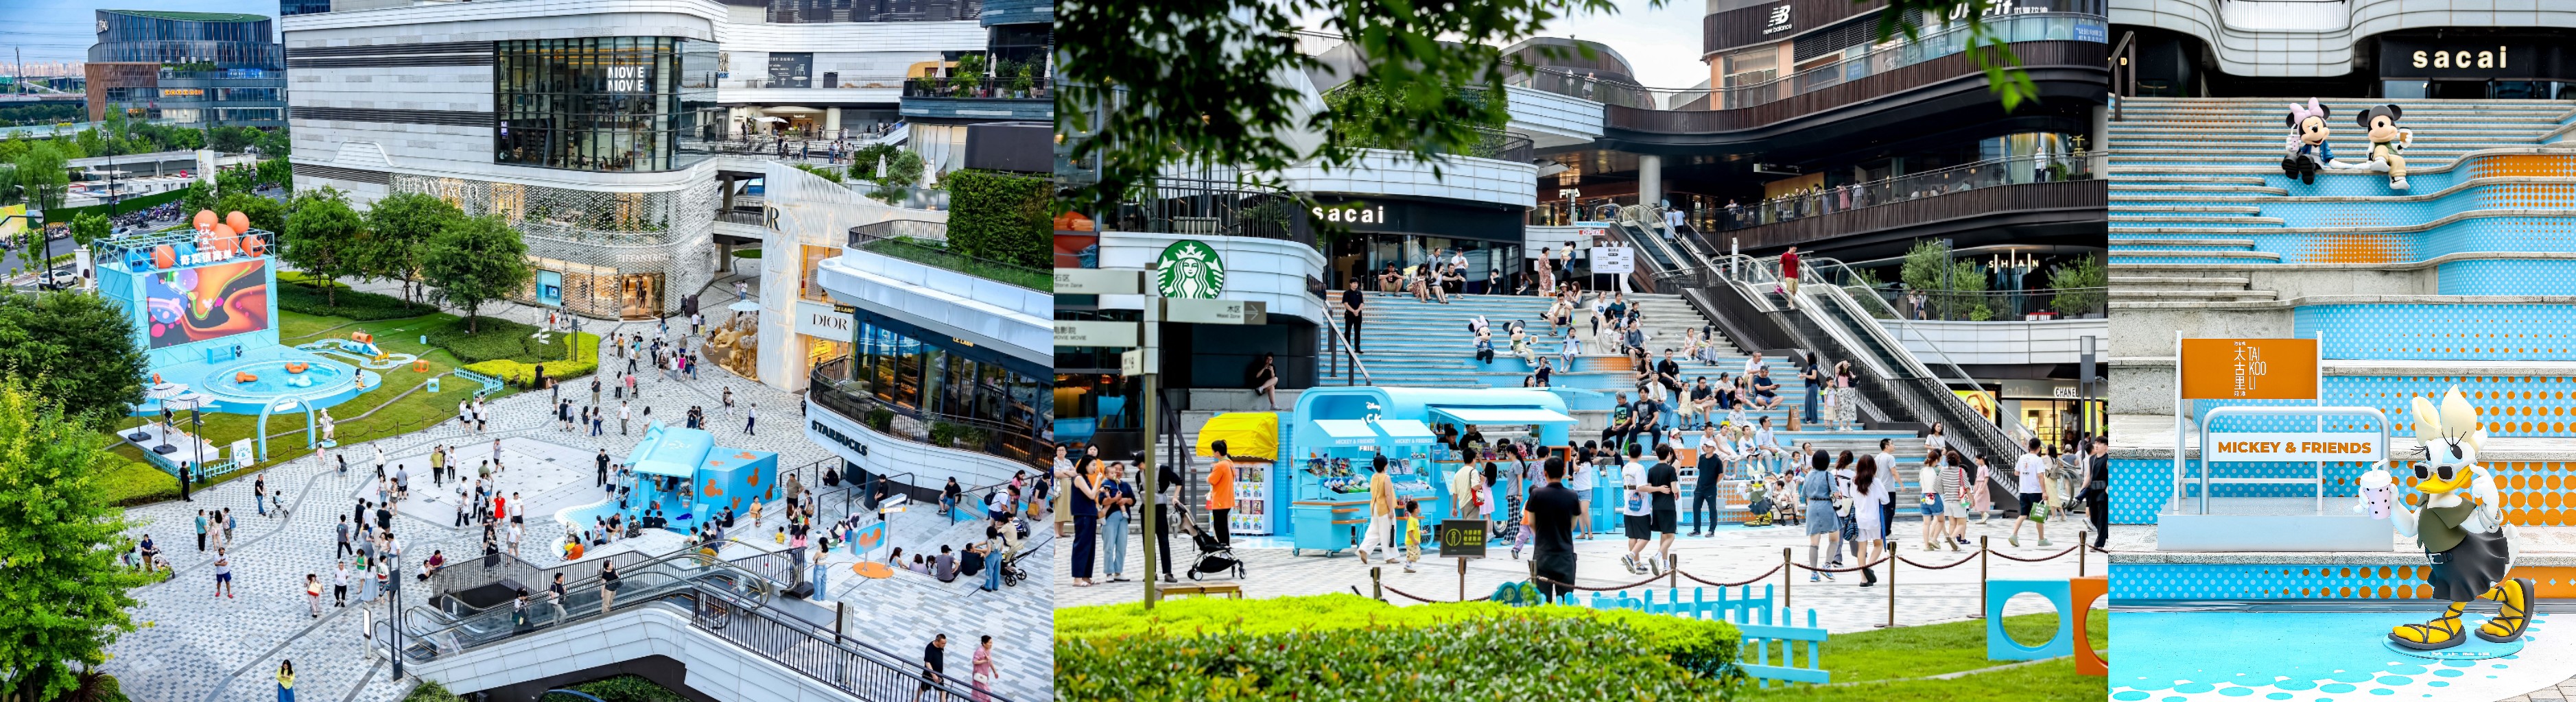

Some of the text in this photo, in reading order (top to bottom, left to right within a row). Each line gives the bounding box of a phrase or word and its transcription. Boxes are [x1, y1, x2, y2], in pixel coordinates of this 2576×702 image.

[1773, 24, 1792, 33] balance
[2412, 45, 2507, 69] sacai
[608, 66, 644, 78] MOVIE
[608, 80, 644, 91] MOVIE
[1559, 188, 1581, 199] FIA
[1312, 206, 1384, 223] sacai
[813, 313, 847, 330] DIOR
[1054, 326, 1076, 335] 电影院
[2247, 346, 2260, 361] TAI
[2234, 346, 2246, 390] 太古里
[2249, 361, 2267, 376] KOO
[2249, 376, 2256, 390] LI
[2055, 387, 2079, 398] CHANEL
[1365, 402, 1381, 411] Disney
[812, 420, 868, 457] STARBUCKS
[2218, 441, 2372, 454] MICKEY & FRIENDS
